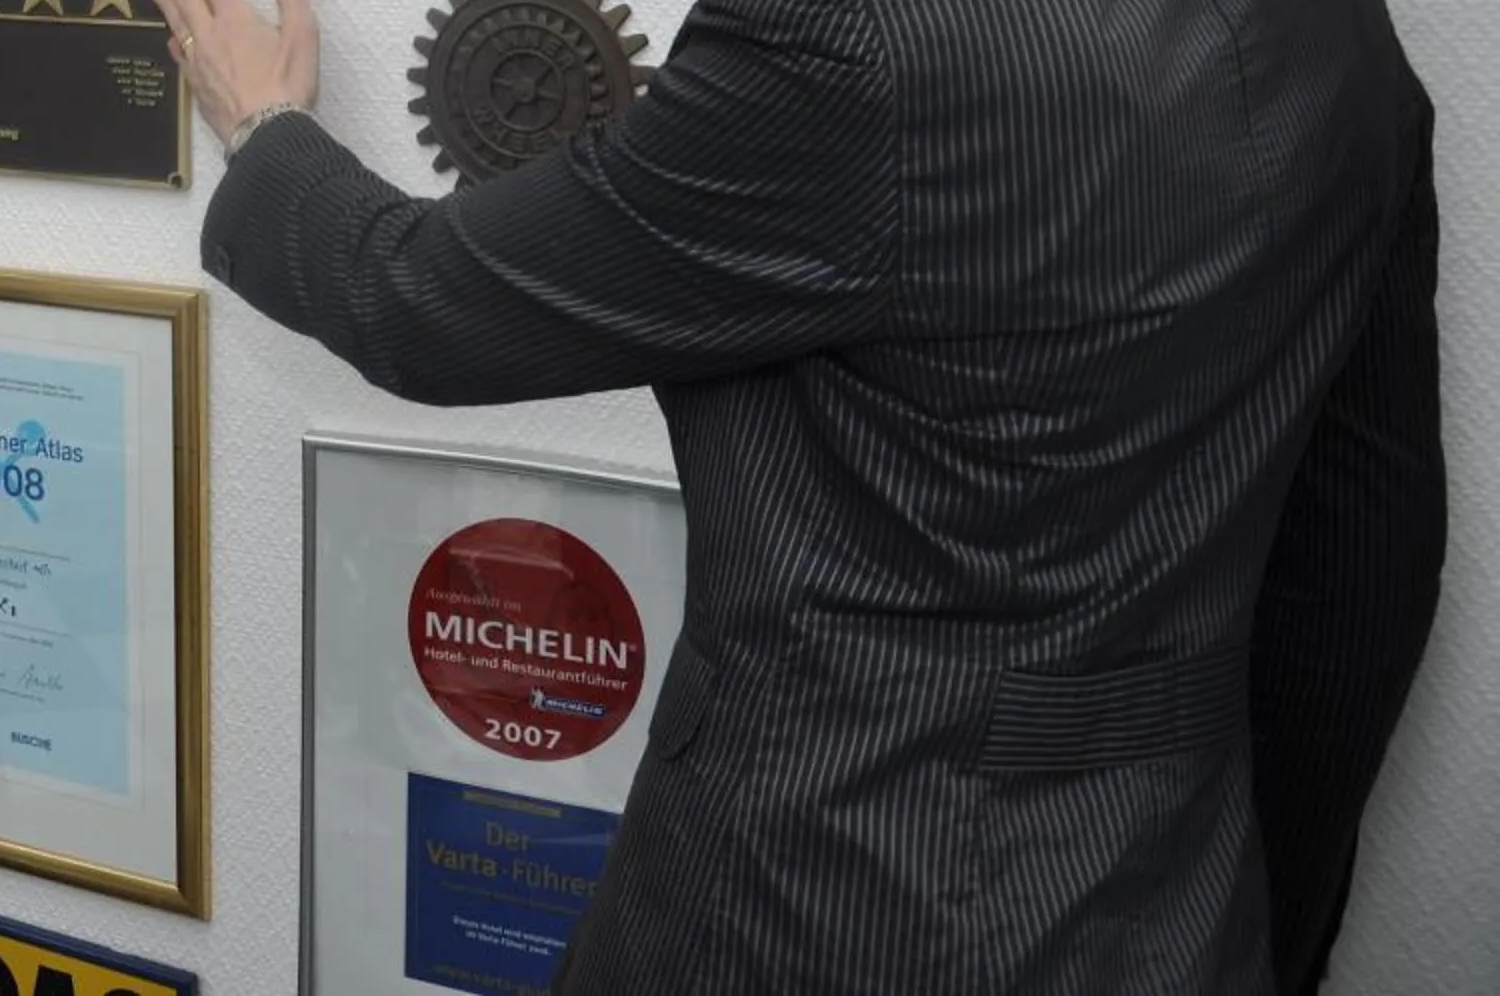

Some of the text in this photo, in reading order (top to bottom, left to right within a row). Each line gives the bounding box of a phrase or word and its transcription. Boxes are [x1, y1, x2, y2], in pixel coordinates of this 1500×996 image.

[36, 437, 84, 463] Atlas
[425, 610, 628, 670] MICHELIN
[424, 647, 628, 691] Hotel- und Restaurantführer
[484, 718, 562, 750] 2007
[485, 821, 531, 852] Der
